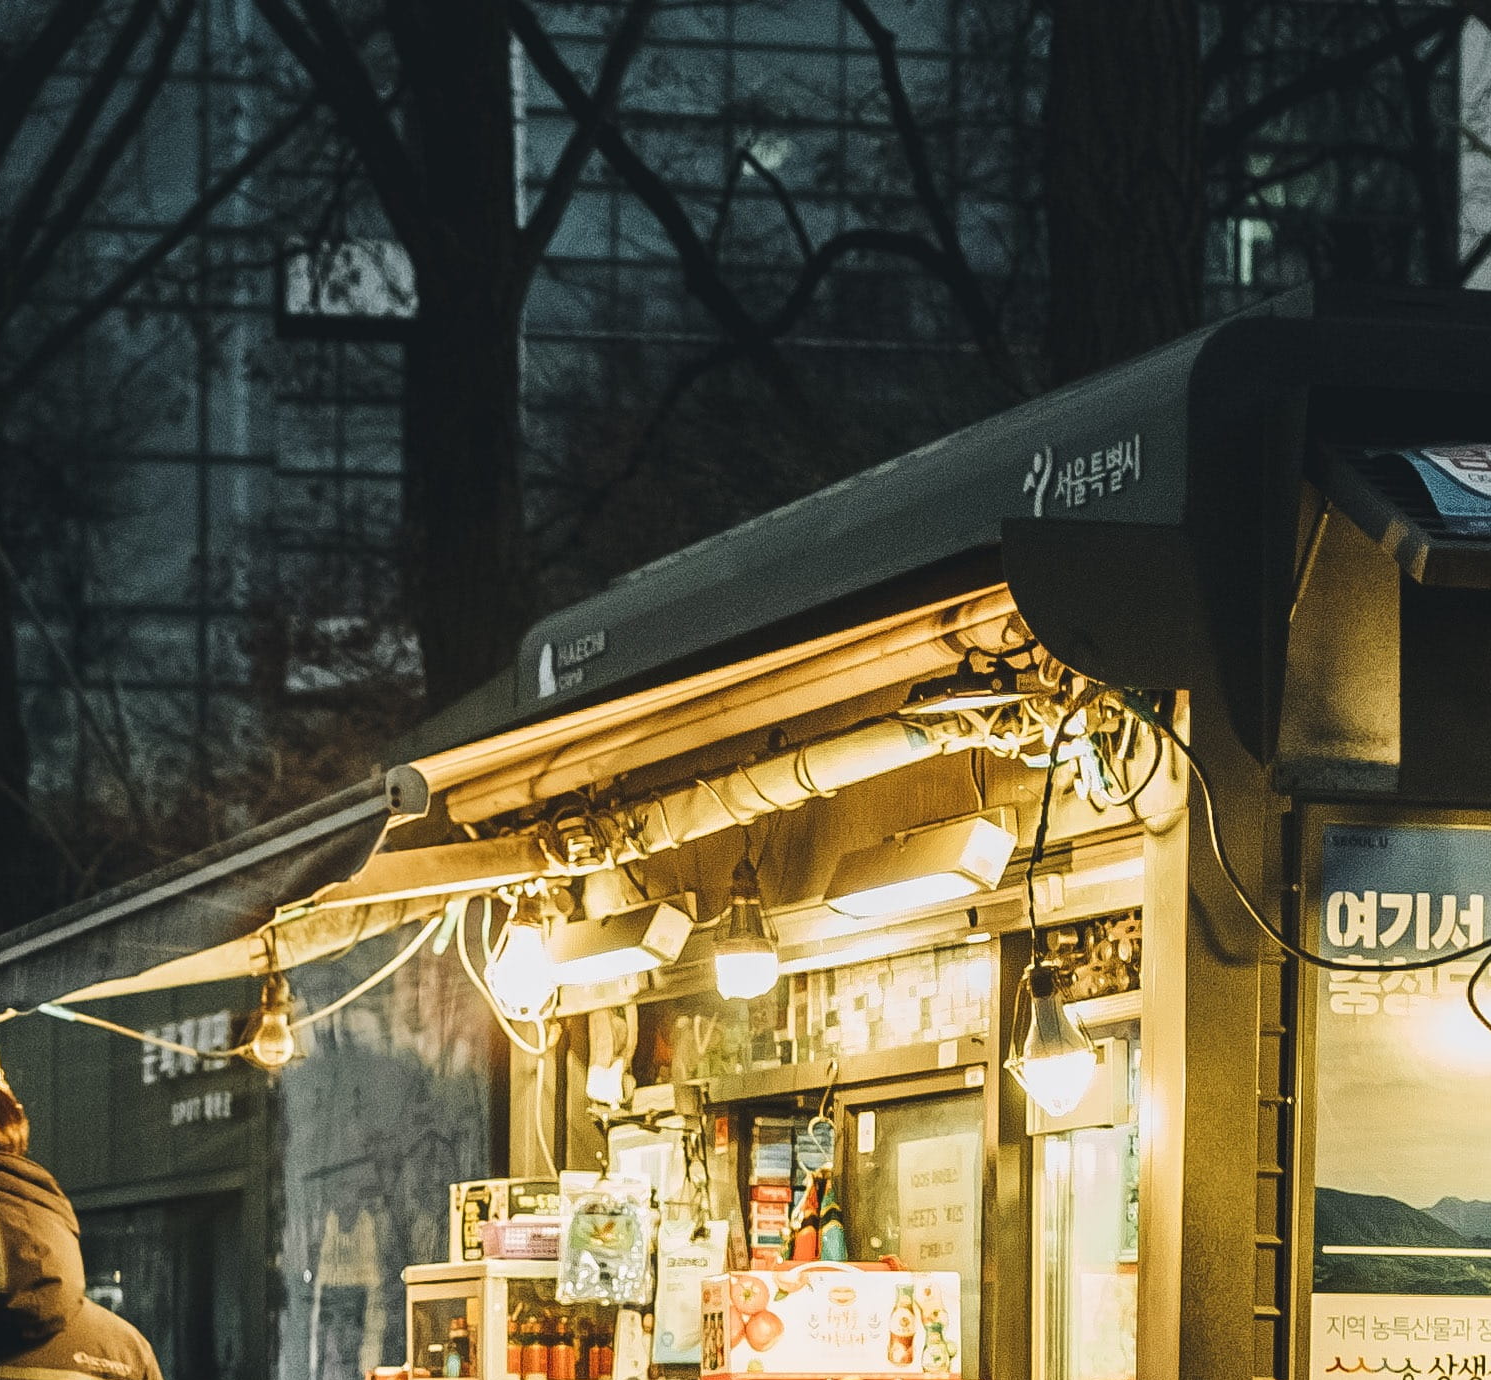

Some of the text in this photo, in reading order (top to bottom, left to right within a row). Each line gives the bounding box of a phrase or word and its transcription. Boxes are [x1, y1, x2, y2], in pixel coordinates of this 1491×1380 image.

[1055, 434, 1141, 508] 서울특별시
[1326, 890, 1485, 950] 여기서
[1326, 1315, 1367, 1341] 지역
[1372, 1315, 1471, 1342] 농특산물과
